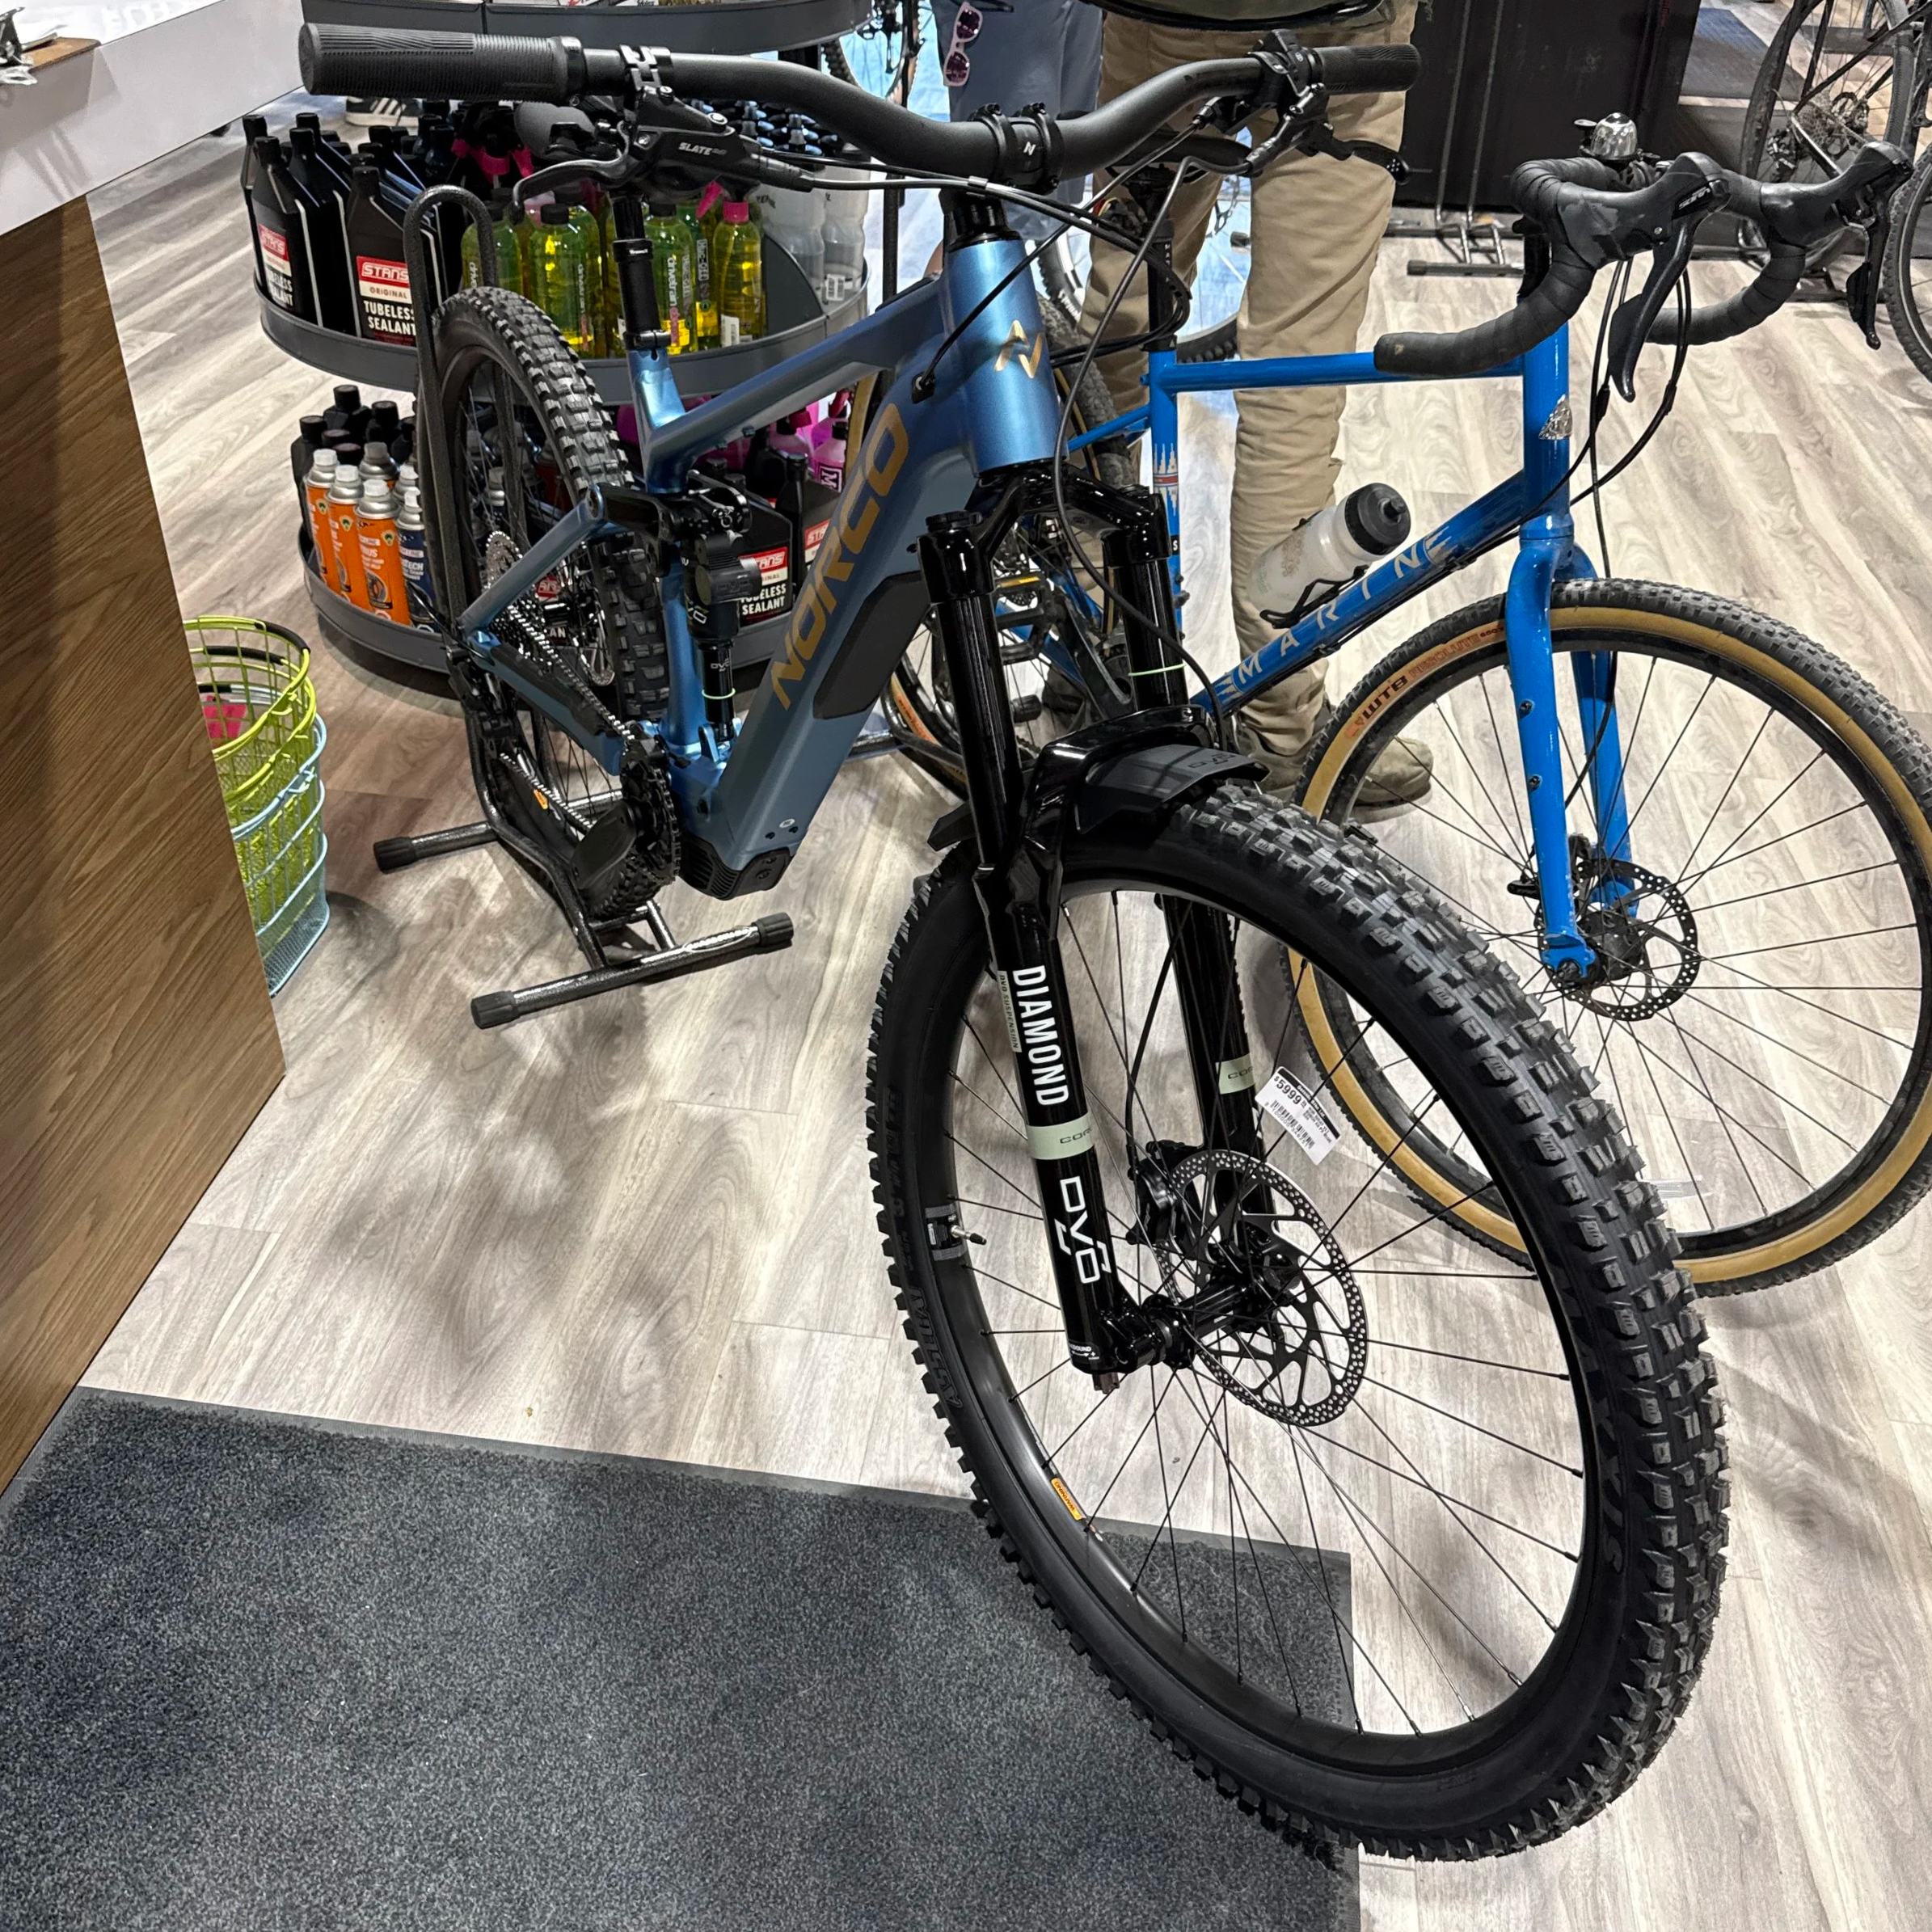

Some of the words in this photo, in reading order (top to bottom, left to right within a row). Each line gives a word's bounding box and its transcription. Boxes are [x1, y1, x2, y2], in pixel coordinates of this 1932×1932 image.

[678, 141, 712, 156] SLATE
[369, 285, 407, 299] ORIGINAL
[667, 257, 678, 306] drivetrain
[770, 403, 909, 711] NORCO
[741, 596, 786, 616] SEALANT
[1237, 544, 1424, 685] MARIN
[1362, 676, 1408, 719] WTB
[1002, 993, 1019, 1050] SUSPENSION
[1013, 964, 1070, 1107] DIAMOND
[1054, 1175, 1112, 1284] DVO
[908, 1286, 963, 1409] ASSEGAI
[1053, 1481, 1075, 1511] WARNING
